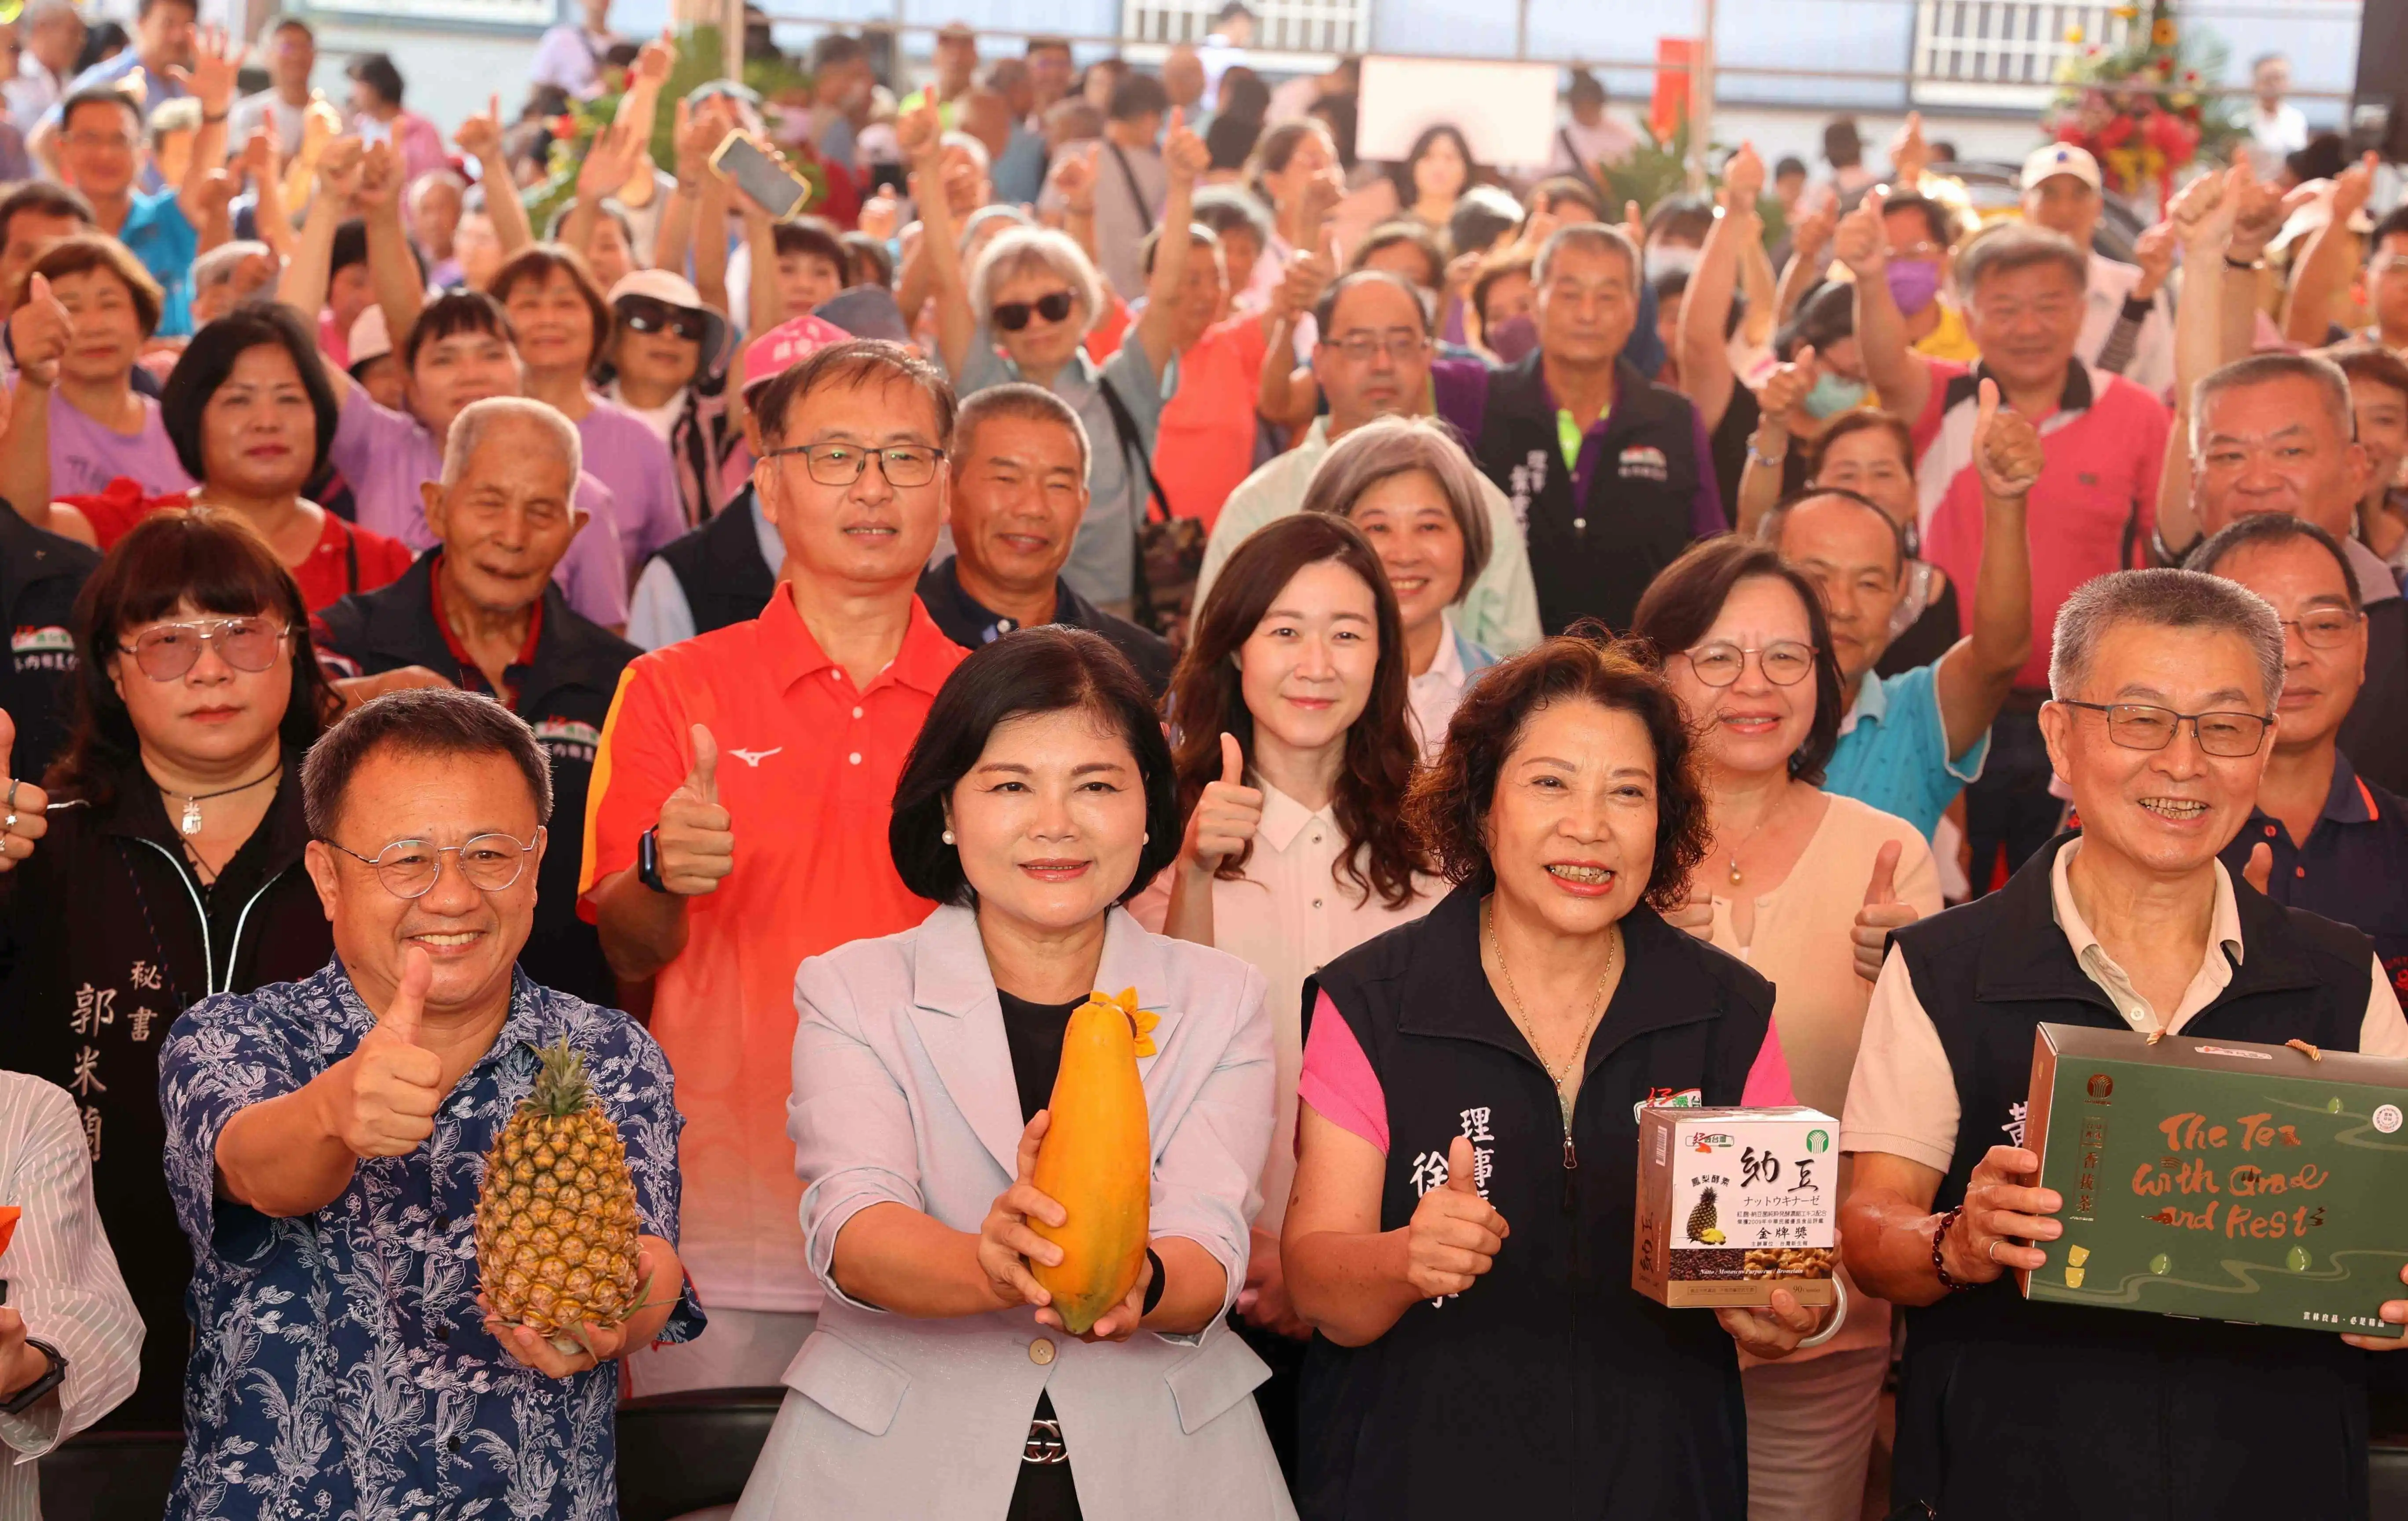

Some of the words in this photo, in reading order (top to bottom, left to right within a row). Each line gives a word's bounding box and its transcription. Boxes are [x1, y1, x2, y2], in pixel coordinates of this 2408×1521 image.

[127, 960, 162, 1042] 秘書
[2158, 1112, 2228, 1152] The
[2237, 1112, 2302, 1151] Tea
[1740, 1146, 1819, 1193] 納豆
[1744, 1195, 1820, 1207] ナットウキナーゼ
[2160, 1200, 2219, 1231] and
[2225, 1204, 2308, 1239] Rest
[1793, 1285, 1802, 1293] 90
